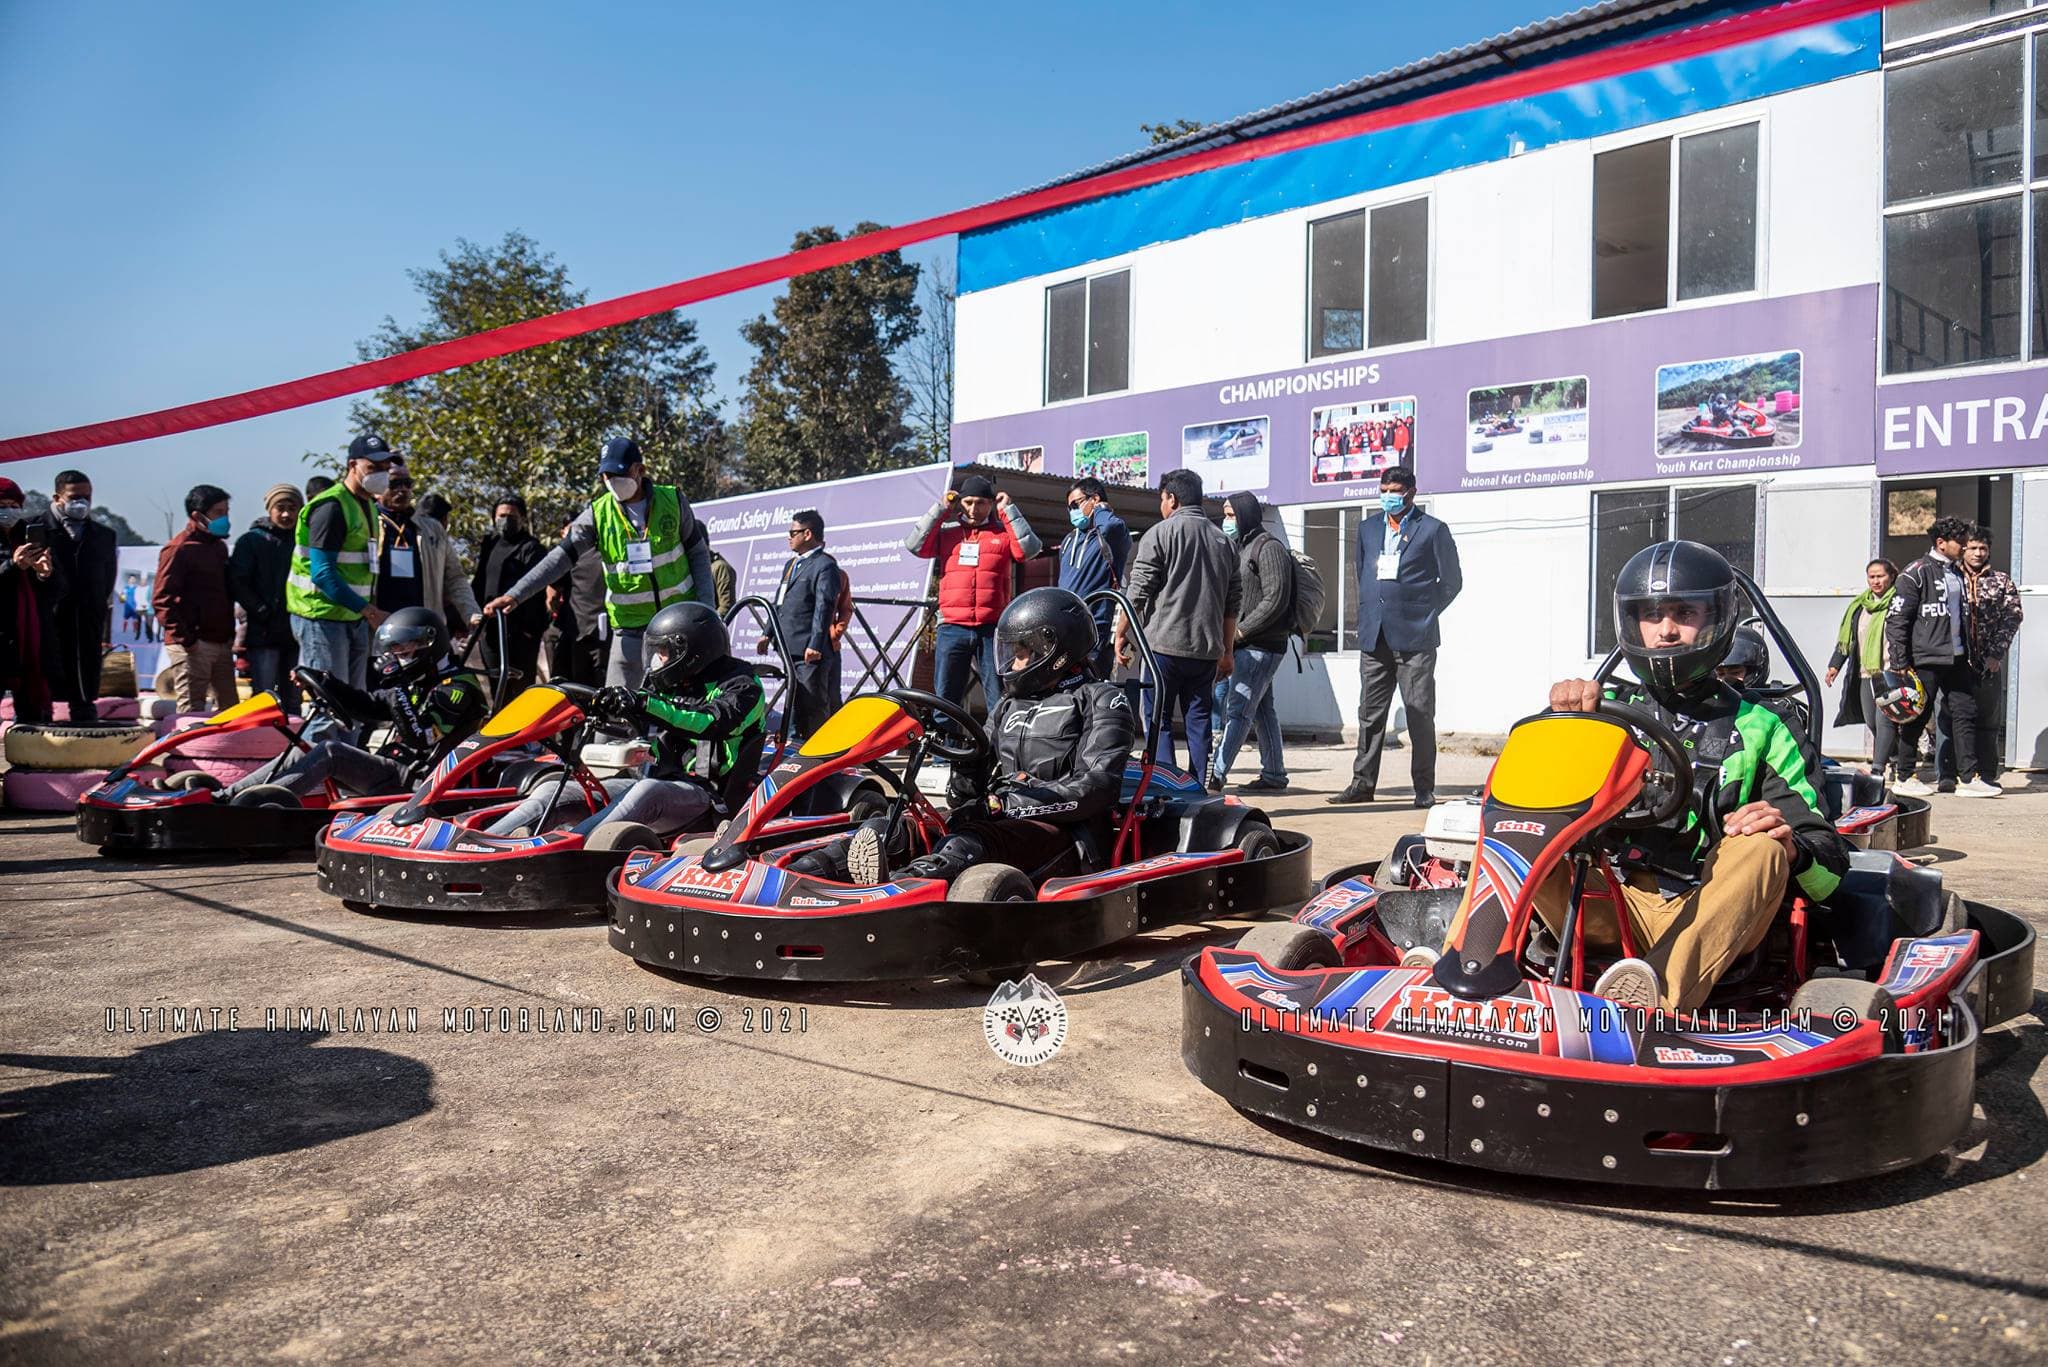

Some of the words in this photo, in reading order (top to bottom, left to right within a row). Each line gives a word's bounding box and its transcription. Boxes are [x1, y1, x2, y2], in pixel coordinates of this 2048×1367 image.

[1219, 364, 1380, 404] CHAMPIONSHIPS
[1655, 462, 1686, 474] Youth
[1690, 459, 1713, 471] Kart
[1717, 453, 1801, 470] Championship
[1461, 475, 1499, 488] National
[1502, 474, 1521, 485] Kart
[1524, 468, 1595, 484] Championship
[707, 512, 742, 534] Ground
[741, 509, 772, 531] Safety
[1494, 821, 1543, 834] KnK
[678, 867, 742, 892] KnK
[1657, 1047, 1696, 1062] KnK
[1696, 1053, 1732, 1063] karts
